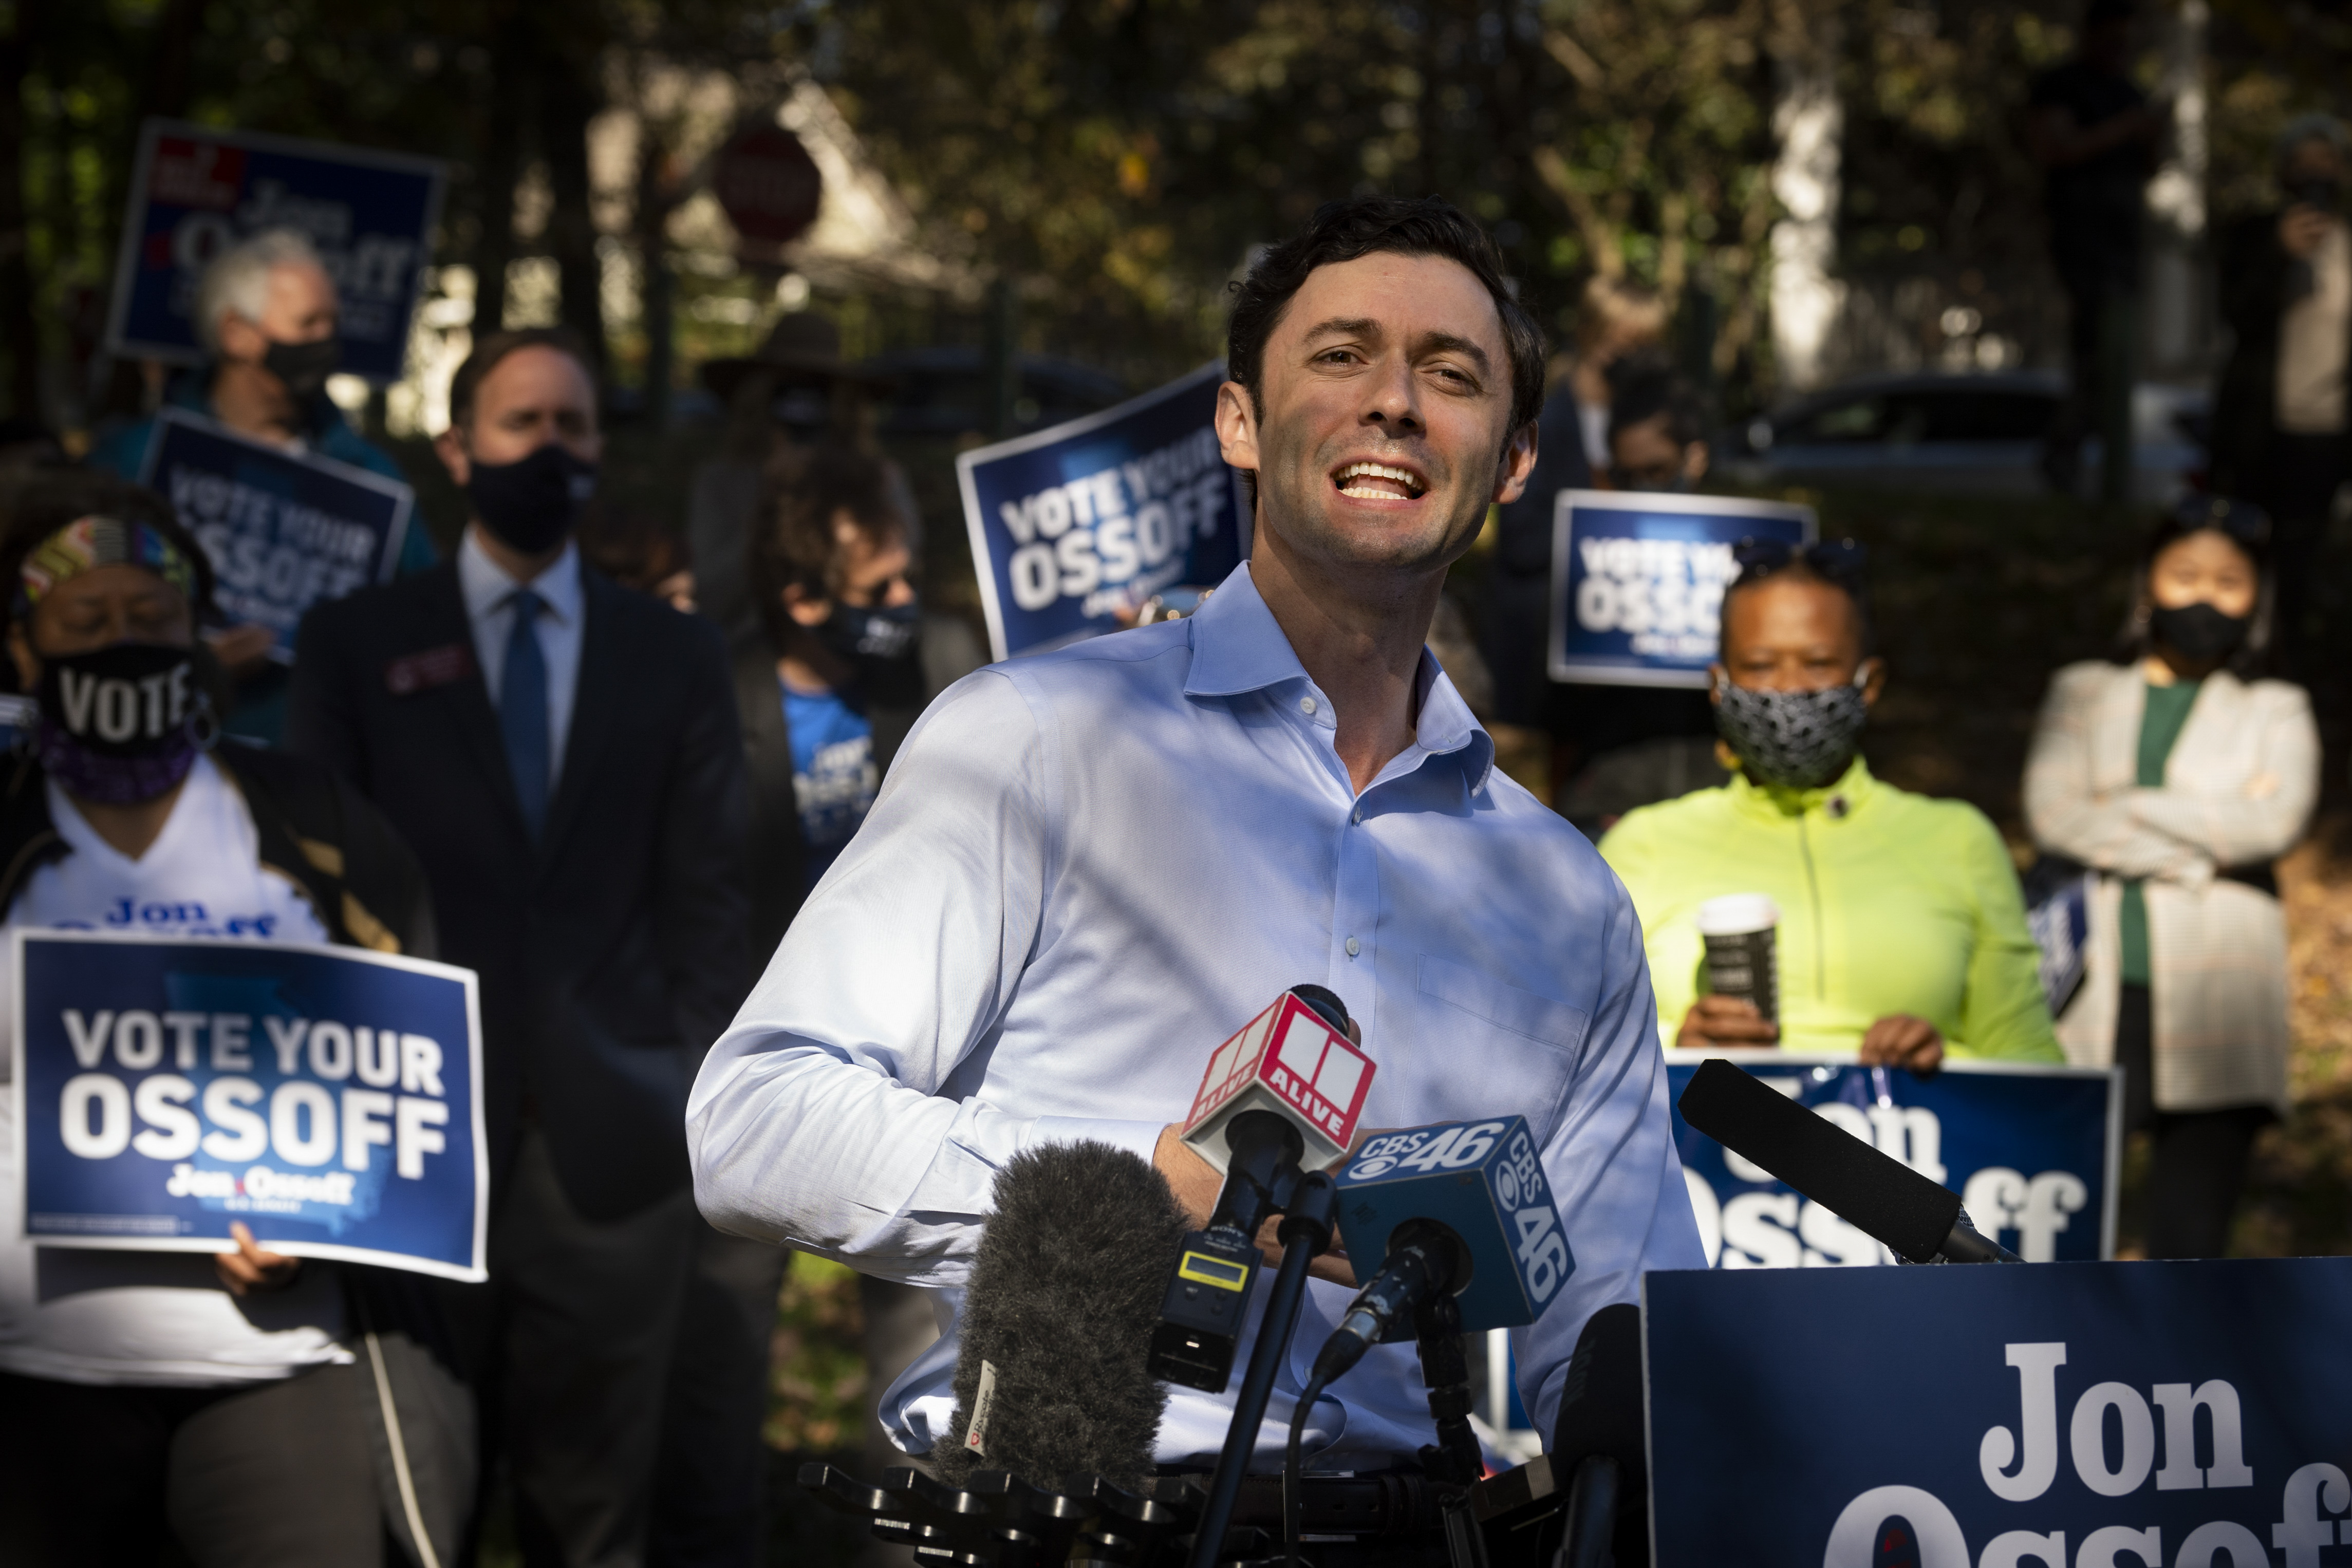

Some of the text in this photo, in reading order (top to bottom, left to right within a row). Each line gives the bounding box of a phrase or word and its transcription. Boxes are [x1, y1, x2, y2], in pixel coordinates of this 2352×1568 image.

[169, 461, 378, 561] VOTE YOUR
[998, 424, 1224, 545] VOTE YOUR
[176, 514, 368, 604] SSOFF
[1010, 469, 1229, 612] OSSOFF
[1579, 535, 1686, 583] VOTE
[1575, 573, 1725, 633] OSSO
[58, 661, 192, 743] VOTE
[107, 897, 210, 925] Jon
[62, 1009, 445, 1096] VOTE YOUR
[1189, 1063, 1255, 1125] ALIVE
[59, 1072, 449, 1180] OSSOFF
[1269, 1067, 1345, 1137] ALIVE
[167, 1164, 235, 1198] Jon
[1359, 1122, 1506, 1172] CBS 46
[1509, 1131, 1568, 1303] CBS 46
[1979, 1341, 2254, 1502] Jon
